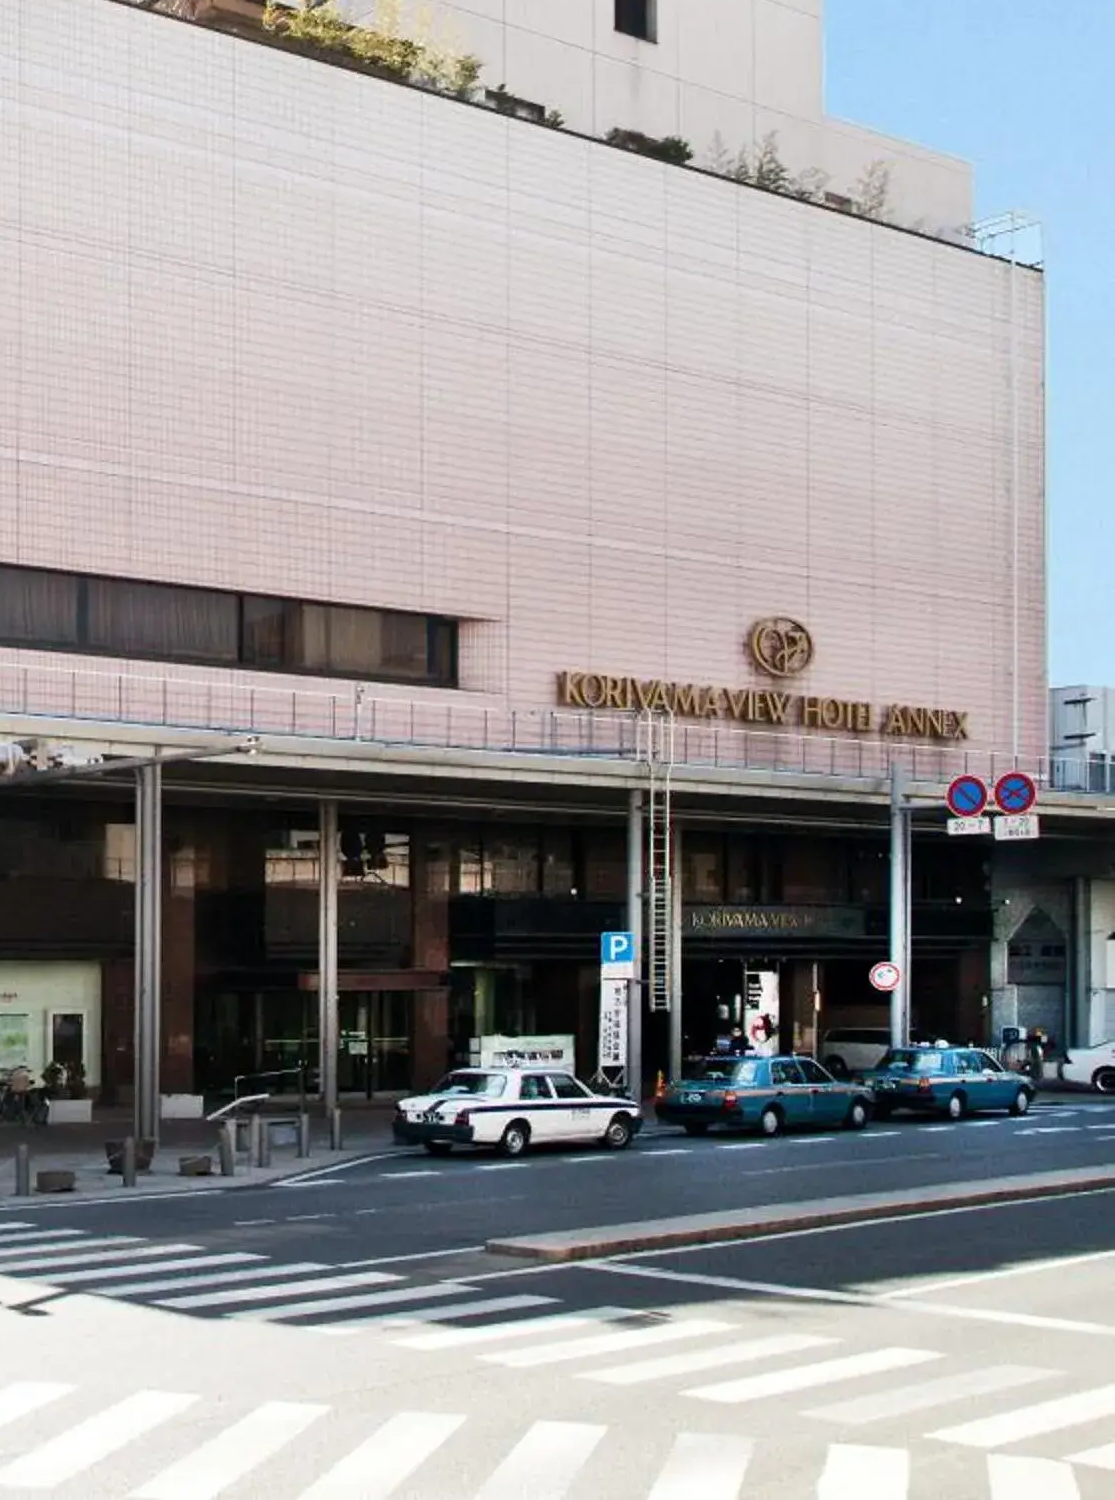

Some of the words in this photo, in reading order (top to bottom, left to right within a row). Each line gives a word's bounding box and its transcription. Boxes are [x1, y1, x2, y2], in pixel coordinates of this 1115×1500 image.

[558, 671, 722, 717] KORIYAMA
[723, 687, 791, 724] VIEW
[799, 696, 872, 732] HOTEL
[884, 703, 968, 739] ANNEX
[610, 935, 628, 961] P
